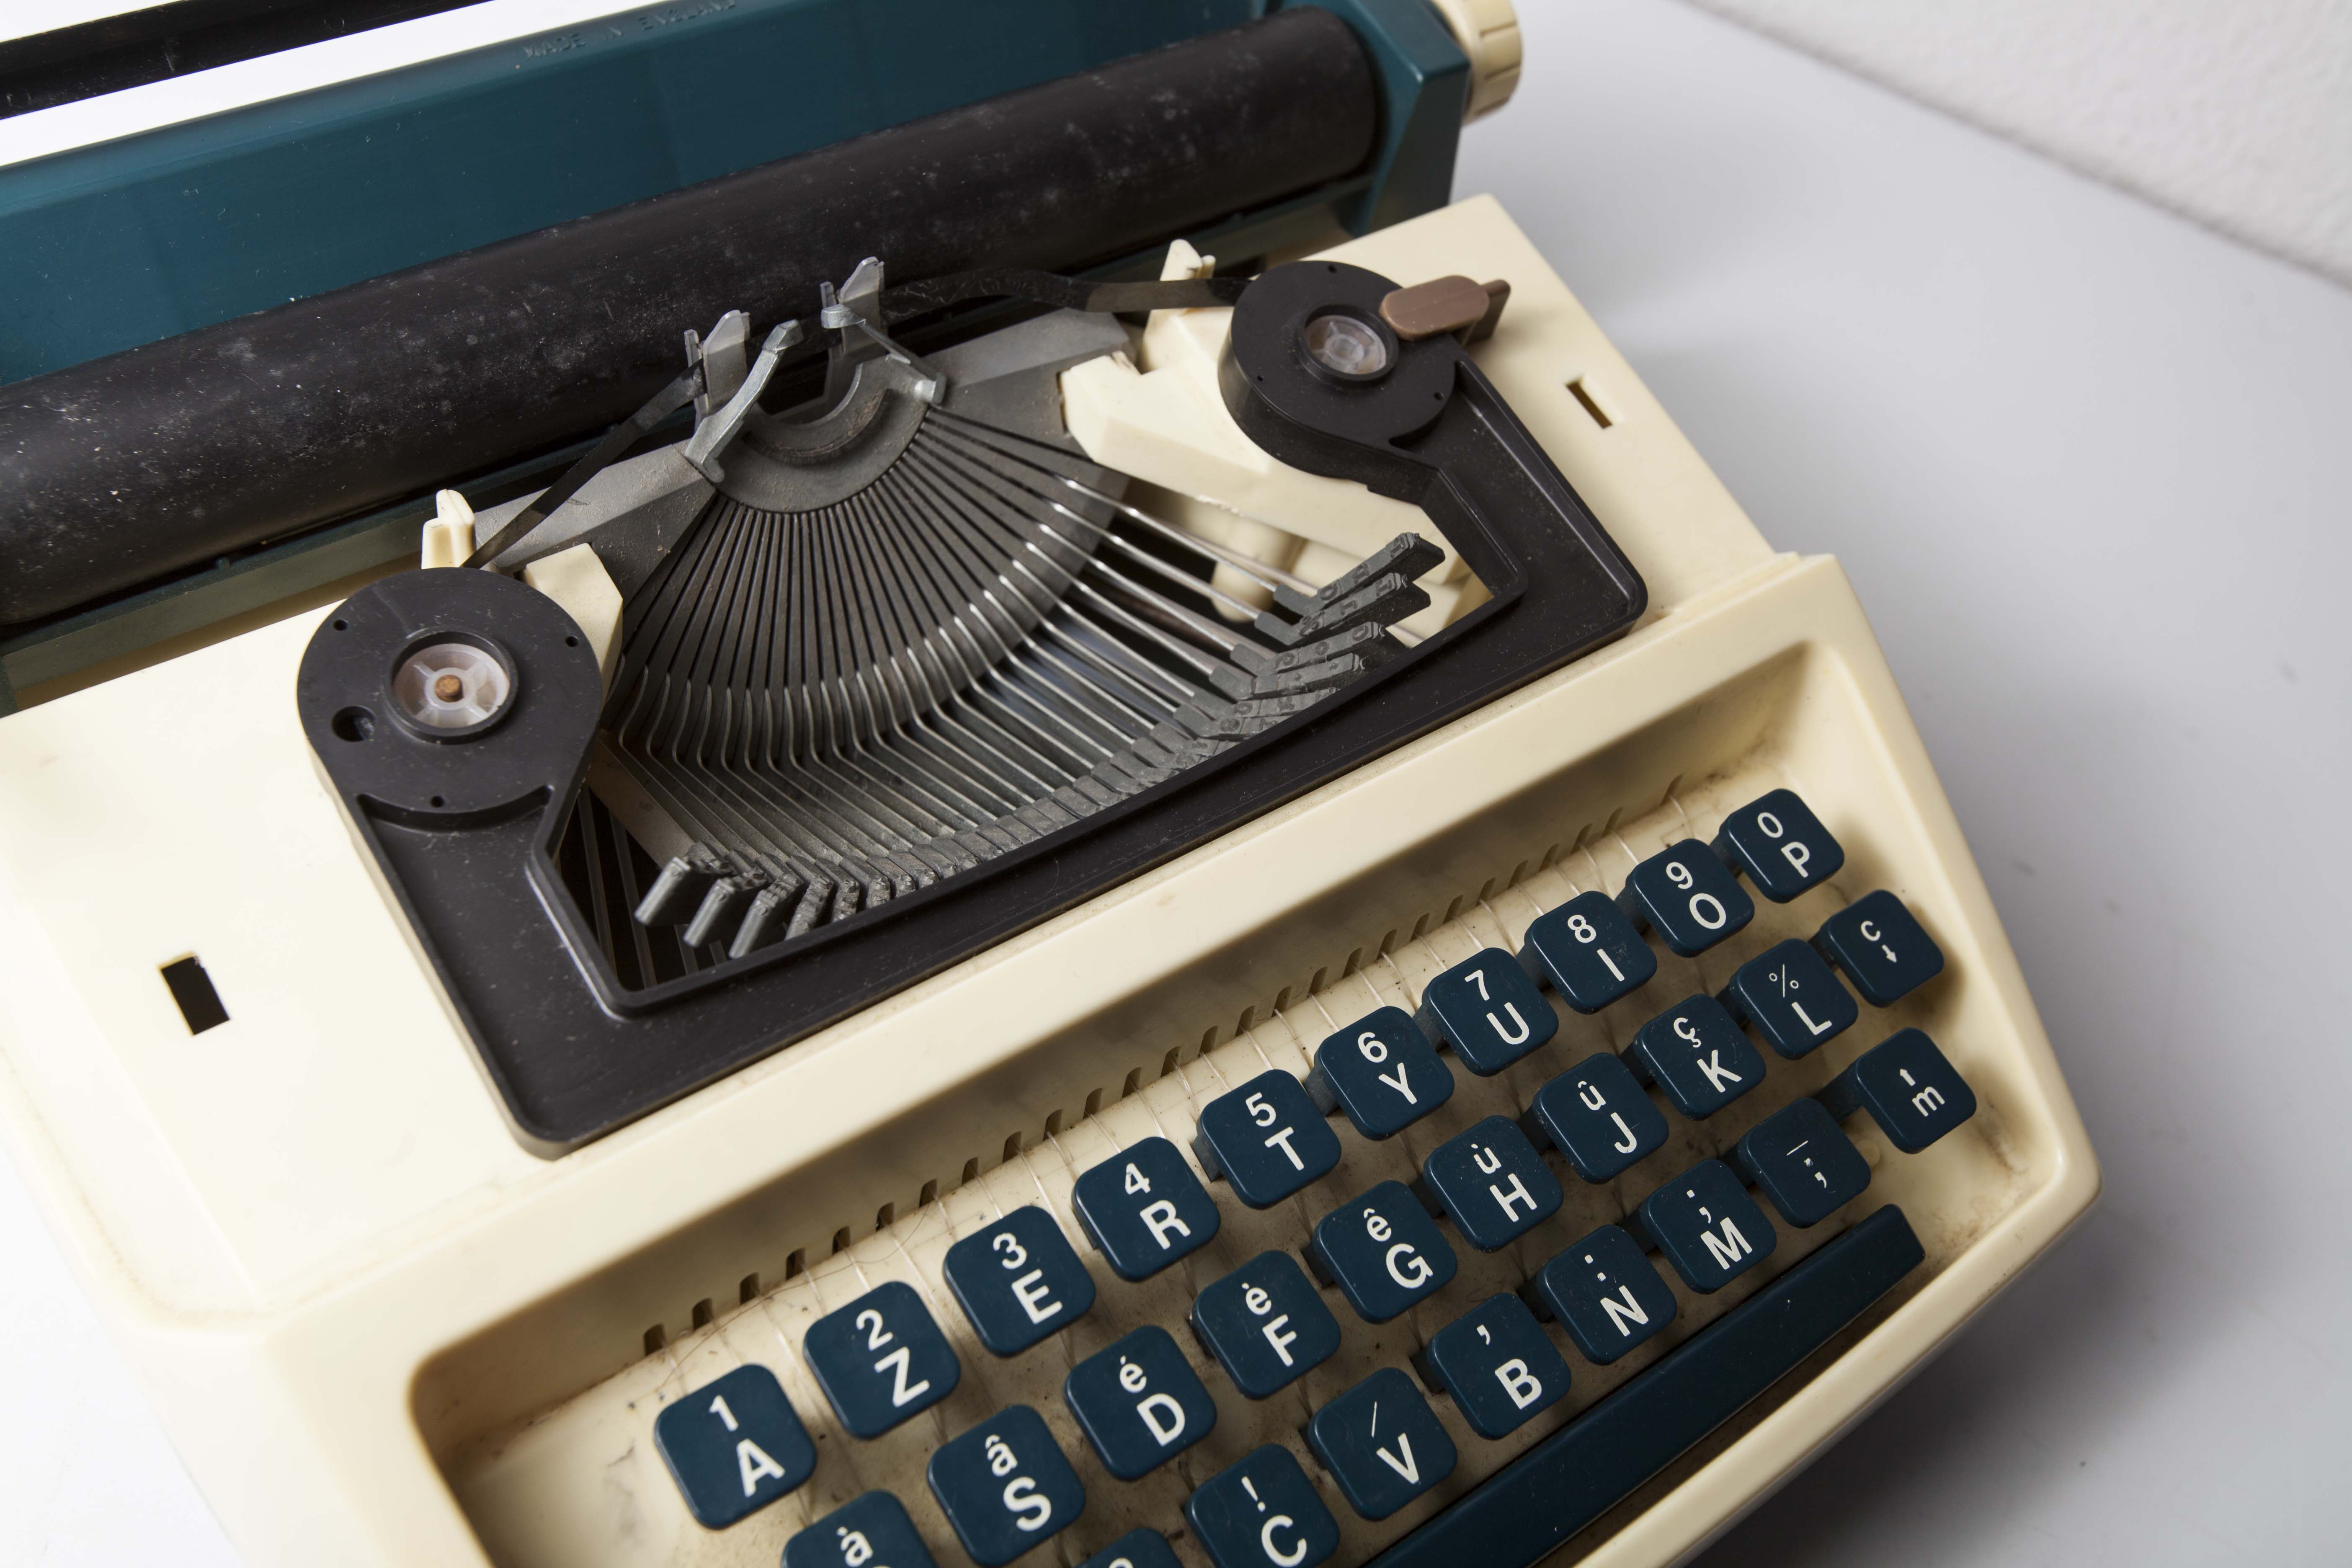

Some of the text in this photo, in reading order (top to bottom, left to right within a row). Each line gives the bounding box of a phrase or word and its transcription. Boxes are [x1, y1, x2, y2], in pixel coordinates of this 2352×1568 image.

[1666, 861, 1693, 890] 9
[1781, 841, 1810, 878] P
[1567, 914, 1596, 944] 8
[1464, 970, 1490, 1001] 7
[1769, 964, 1799, 998] %
[1486, 1002, 1529, 1045] U
[1791, 1001, 1832, 1035] L
[1357, 1032, 1388, 1063] 6
[1378, 1062, 1417, 1105] Y
[1697, 1049, 1742, 1093] K
[1245, 1092, 1277, 1127] 5
[1912, 1086, 1945, 1117] m
[1264, 1126, 1305, 1171] T
[1610, 1112, 1637, 1153] J
[1124, 1163, 1151, 1195] 4
[1489, 1173, 1537, 1222] H
[1140, 1200, 1191, 1250] R
[1700, 1217, 1753, 1270] M
[993, 1233, 1027, 1269] 3
[1385, 1243, 1433, 1289] G
[1011, 1269, 1063, 1325] E
[1600, 1285, 1649, 1337] N
[856, 1309, 893, 1351] 2
[1262, 1314, 1297, 1367] F
[874, 1346, 930, 1408] Z
[1494, 1358, 1542, 1410] B
[709, 1395, 739, 1431] 1
[1136, 1393, 1185, 1447] D
[736, 1439, 785, 1497] A
[1376, 1433, 1419, 1484] V
[1003, 1476, 1052, 1531] S
[1241, 1476, 1266, 1512] !
[1261, 1515, 1307, 1568] C
